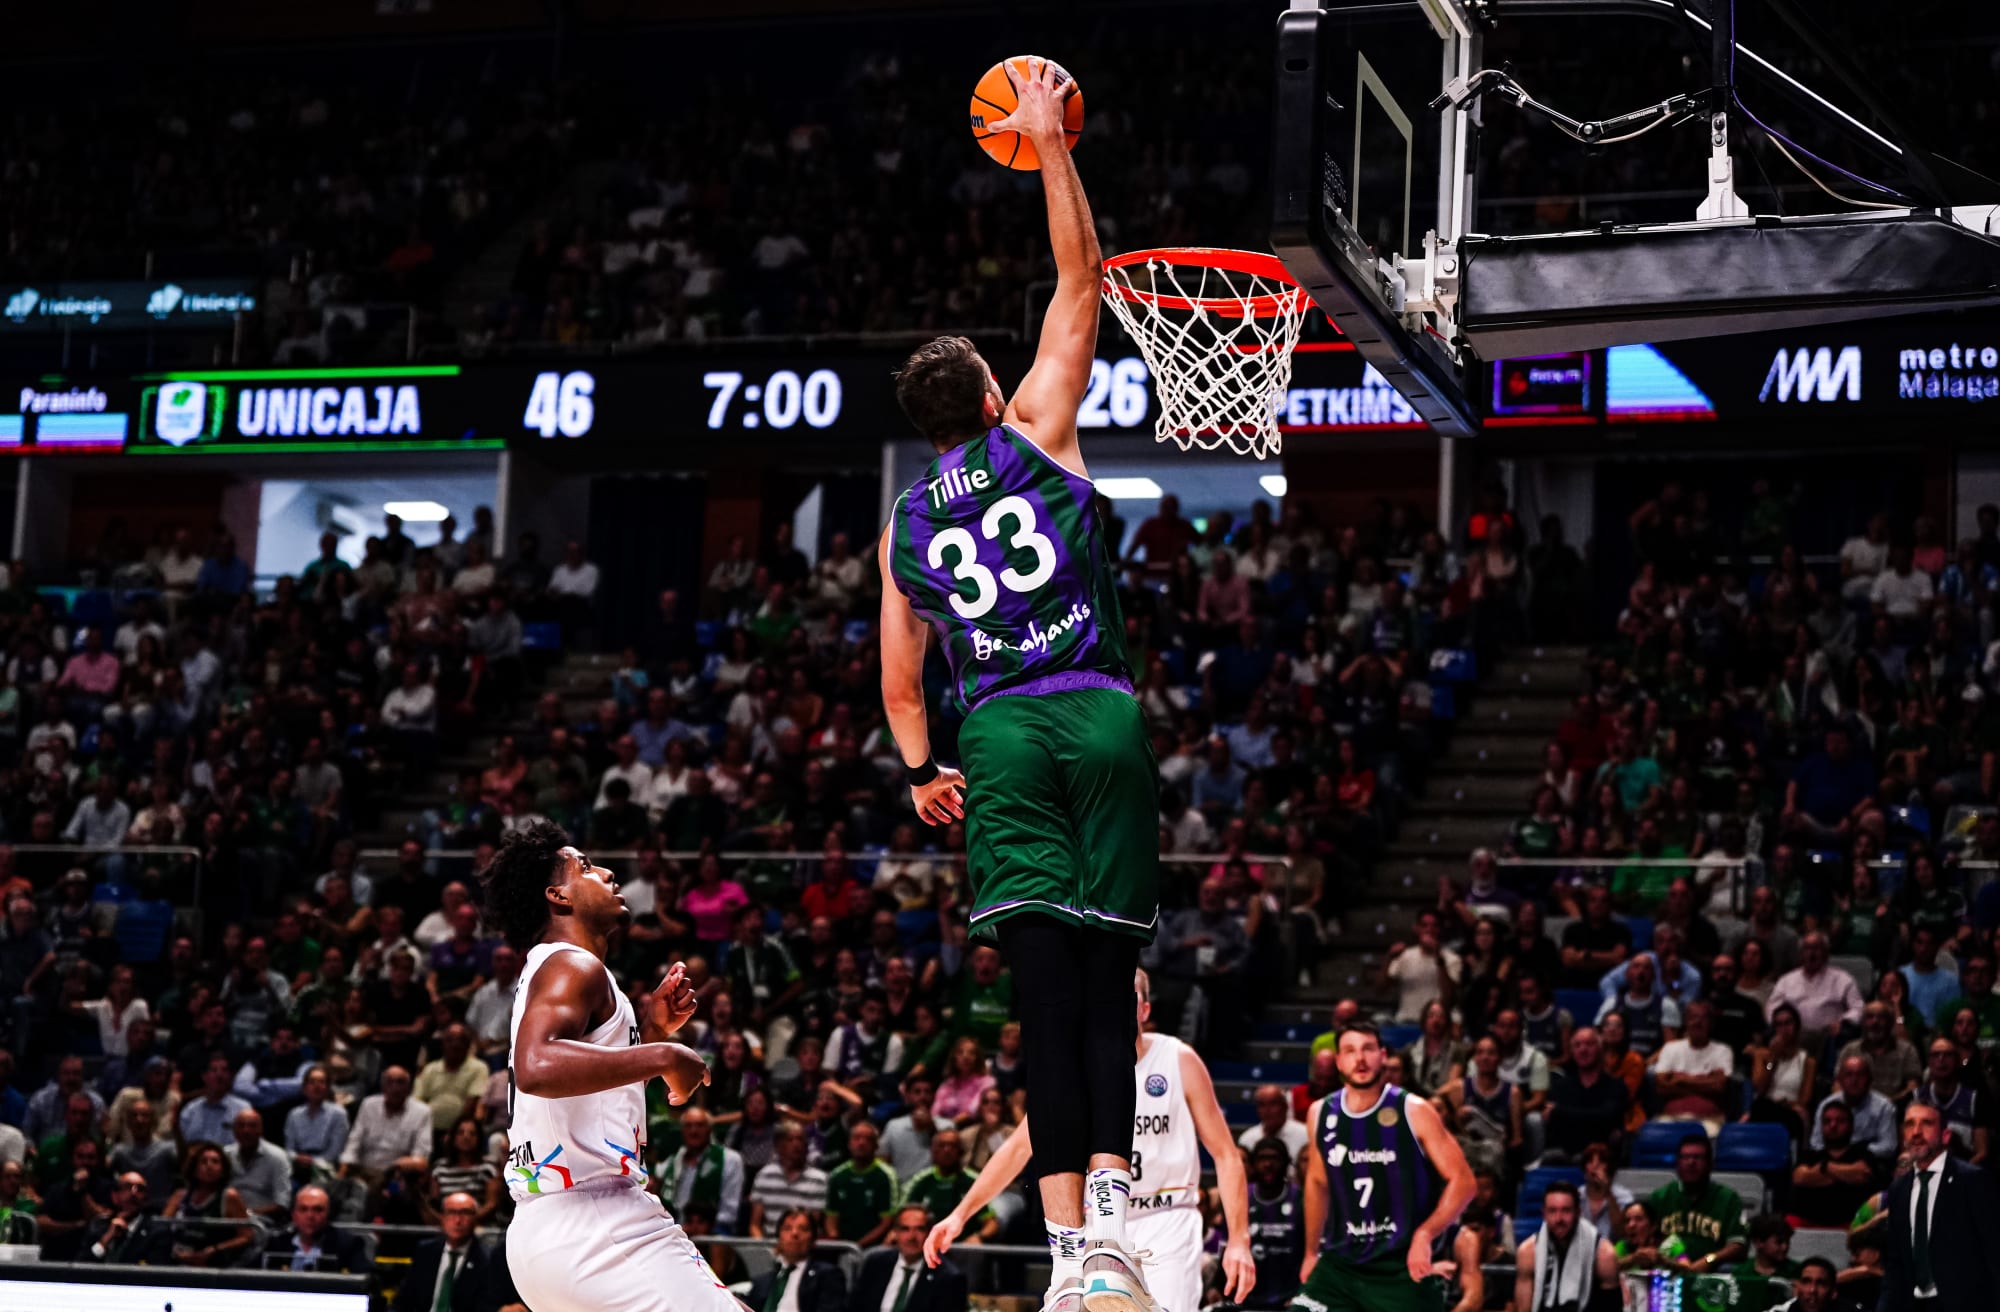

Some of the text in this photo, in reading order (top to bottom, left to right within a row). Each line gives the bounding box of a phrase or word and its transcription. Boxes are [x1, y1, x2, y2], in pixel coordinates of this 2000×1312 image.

[1900, 343, 1999, 370] metro
[19, 386, 108, 412] Paraninfo
[237, 385, 421, 437] UNICAJA
[524, 371, 595, 438] 46
[703, 368, 842, 429] 7:00
[1075, 357, 1149, 429] 26
[928, 467, 990, 509] Tillie
[927, 495, 1057, 619] 33
[1135, 1114, 1170, 1136] SPOR
[1348, 1148, 1396, 1165] Unicaja
[1353, 1176, 1374, 1209] 7
